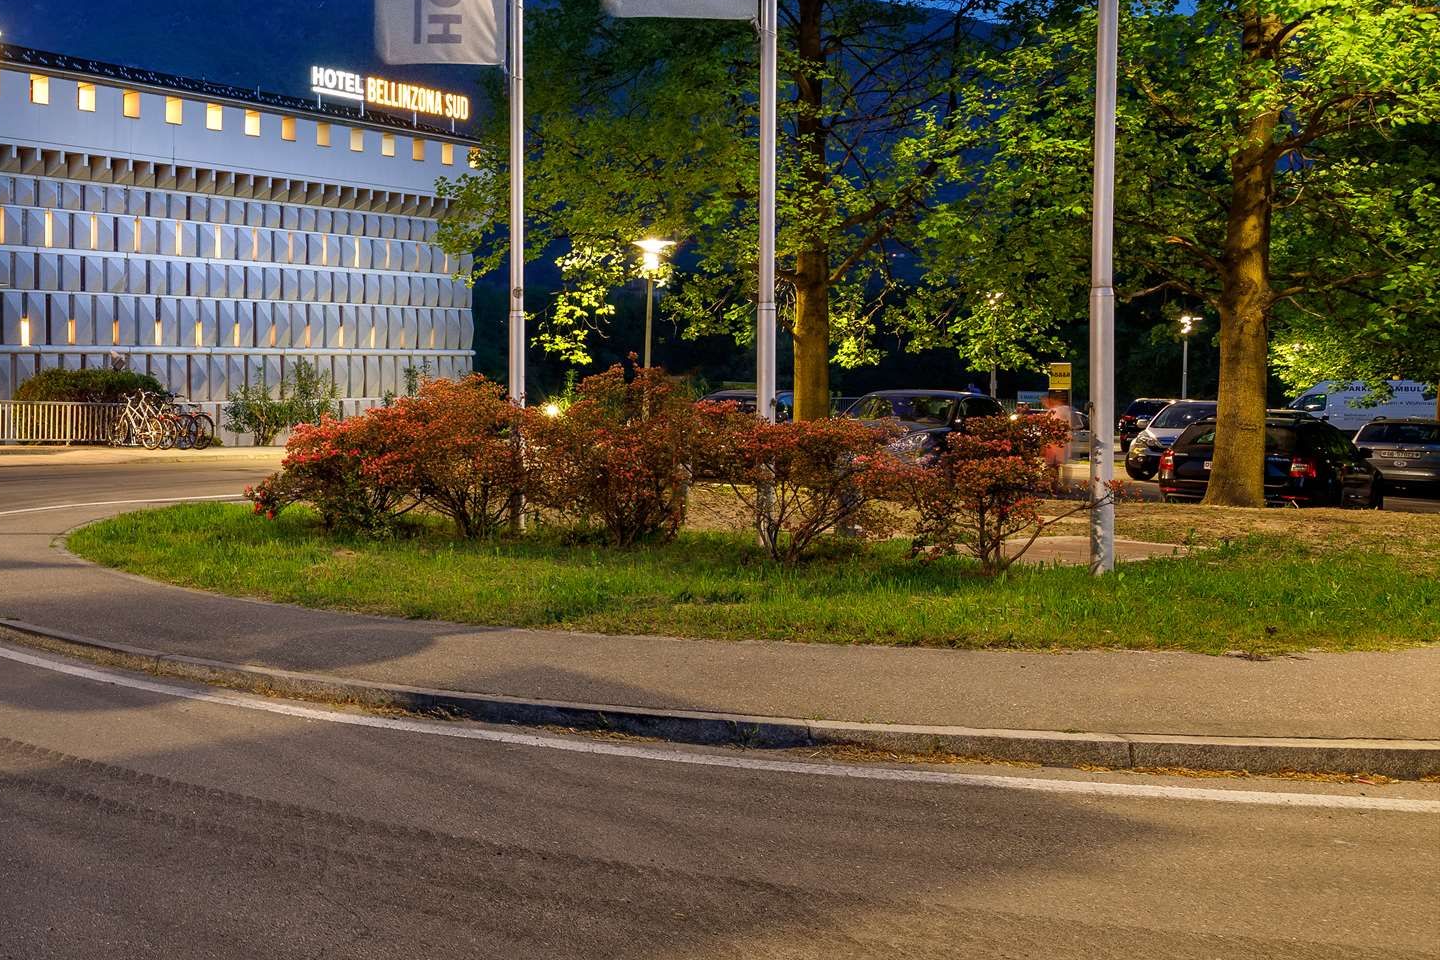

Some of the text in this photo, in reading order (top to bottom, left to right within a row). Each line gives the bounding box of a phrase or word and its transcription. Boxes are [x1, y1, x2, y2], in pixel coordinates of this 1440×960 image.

[312, 65, 469, 121] HOTEL BELLINZONA SUD
